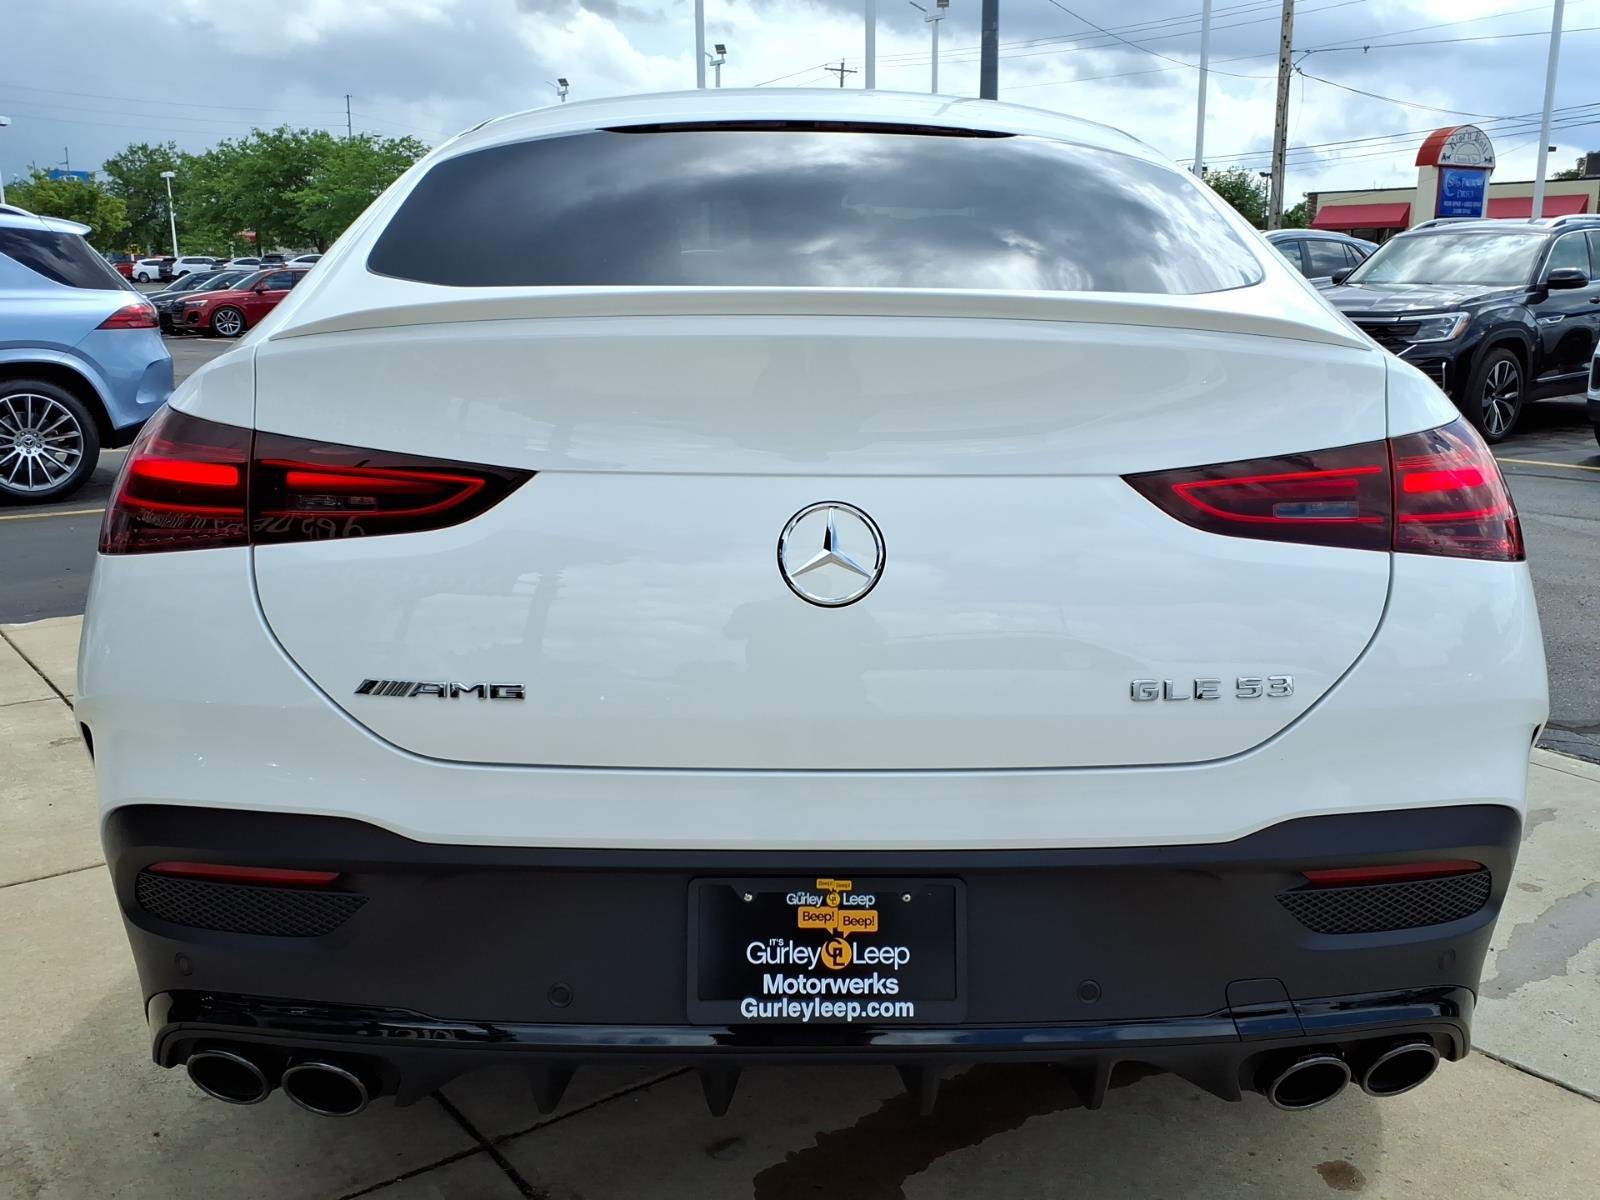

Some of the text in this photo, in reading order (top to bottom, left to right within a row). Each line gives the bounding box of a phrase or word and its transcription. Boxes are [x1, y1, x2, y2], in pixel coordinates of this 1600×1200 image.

[408, 681, 525, 699] AMG
[1130, 675, 1295, 701] GLE 53
[843, 892, 876, 908] Leep
[802, 911, 875, 928] Beep! Beep!
[769, 938, 784, 946] IT'S
[746, 940, 822, 970] Gurley
[853, 942, 910, 970] Leep
[763, 972, 899, 995] Motorwerks
[740, 998, 914, 1022] Gurleyleep.com
